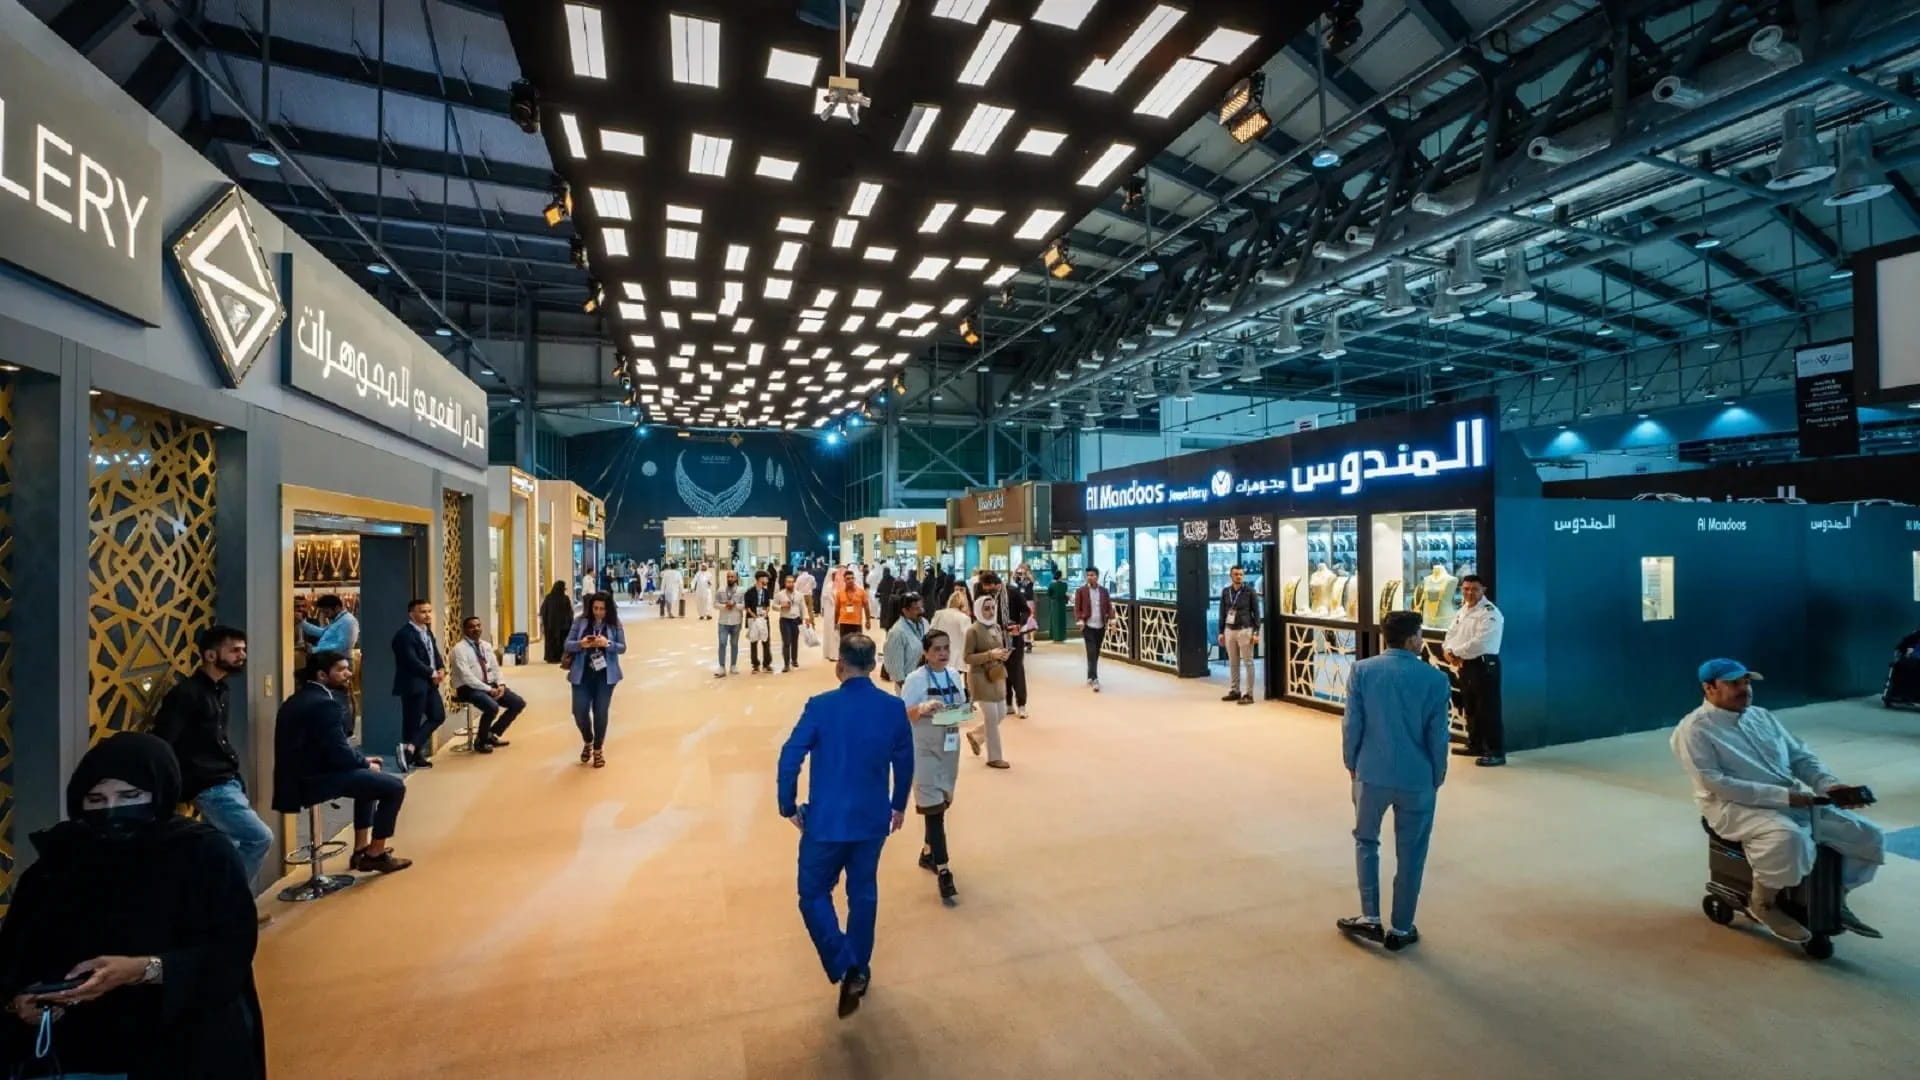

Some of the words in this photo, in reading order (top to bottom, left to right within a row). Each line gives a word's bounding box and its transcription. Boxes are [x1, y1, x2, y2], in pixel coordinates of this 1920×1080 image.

[297, 305, 409, 408] للمجوهرات
[1292, 418, 1486, 495] المندوس
[1086, 486, 1098, 511] Al
[1100, 480, 1165, 510] Mandoos
[1168, 486, 1208, 503] Jewellery
[1235, 478, 1288, 497] مجوهرات
[1554, 514, 1616, 534] المندوس
[1697, 517, 1706, 531] Al
[1708, 517, 1747, 531] Mandoos
[1810, 516, 1851, 533] المندوس
